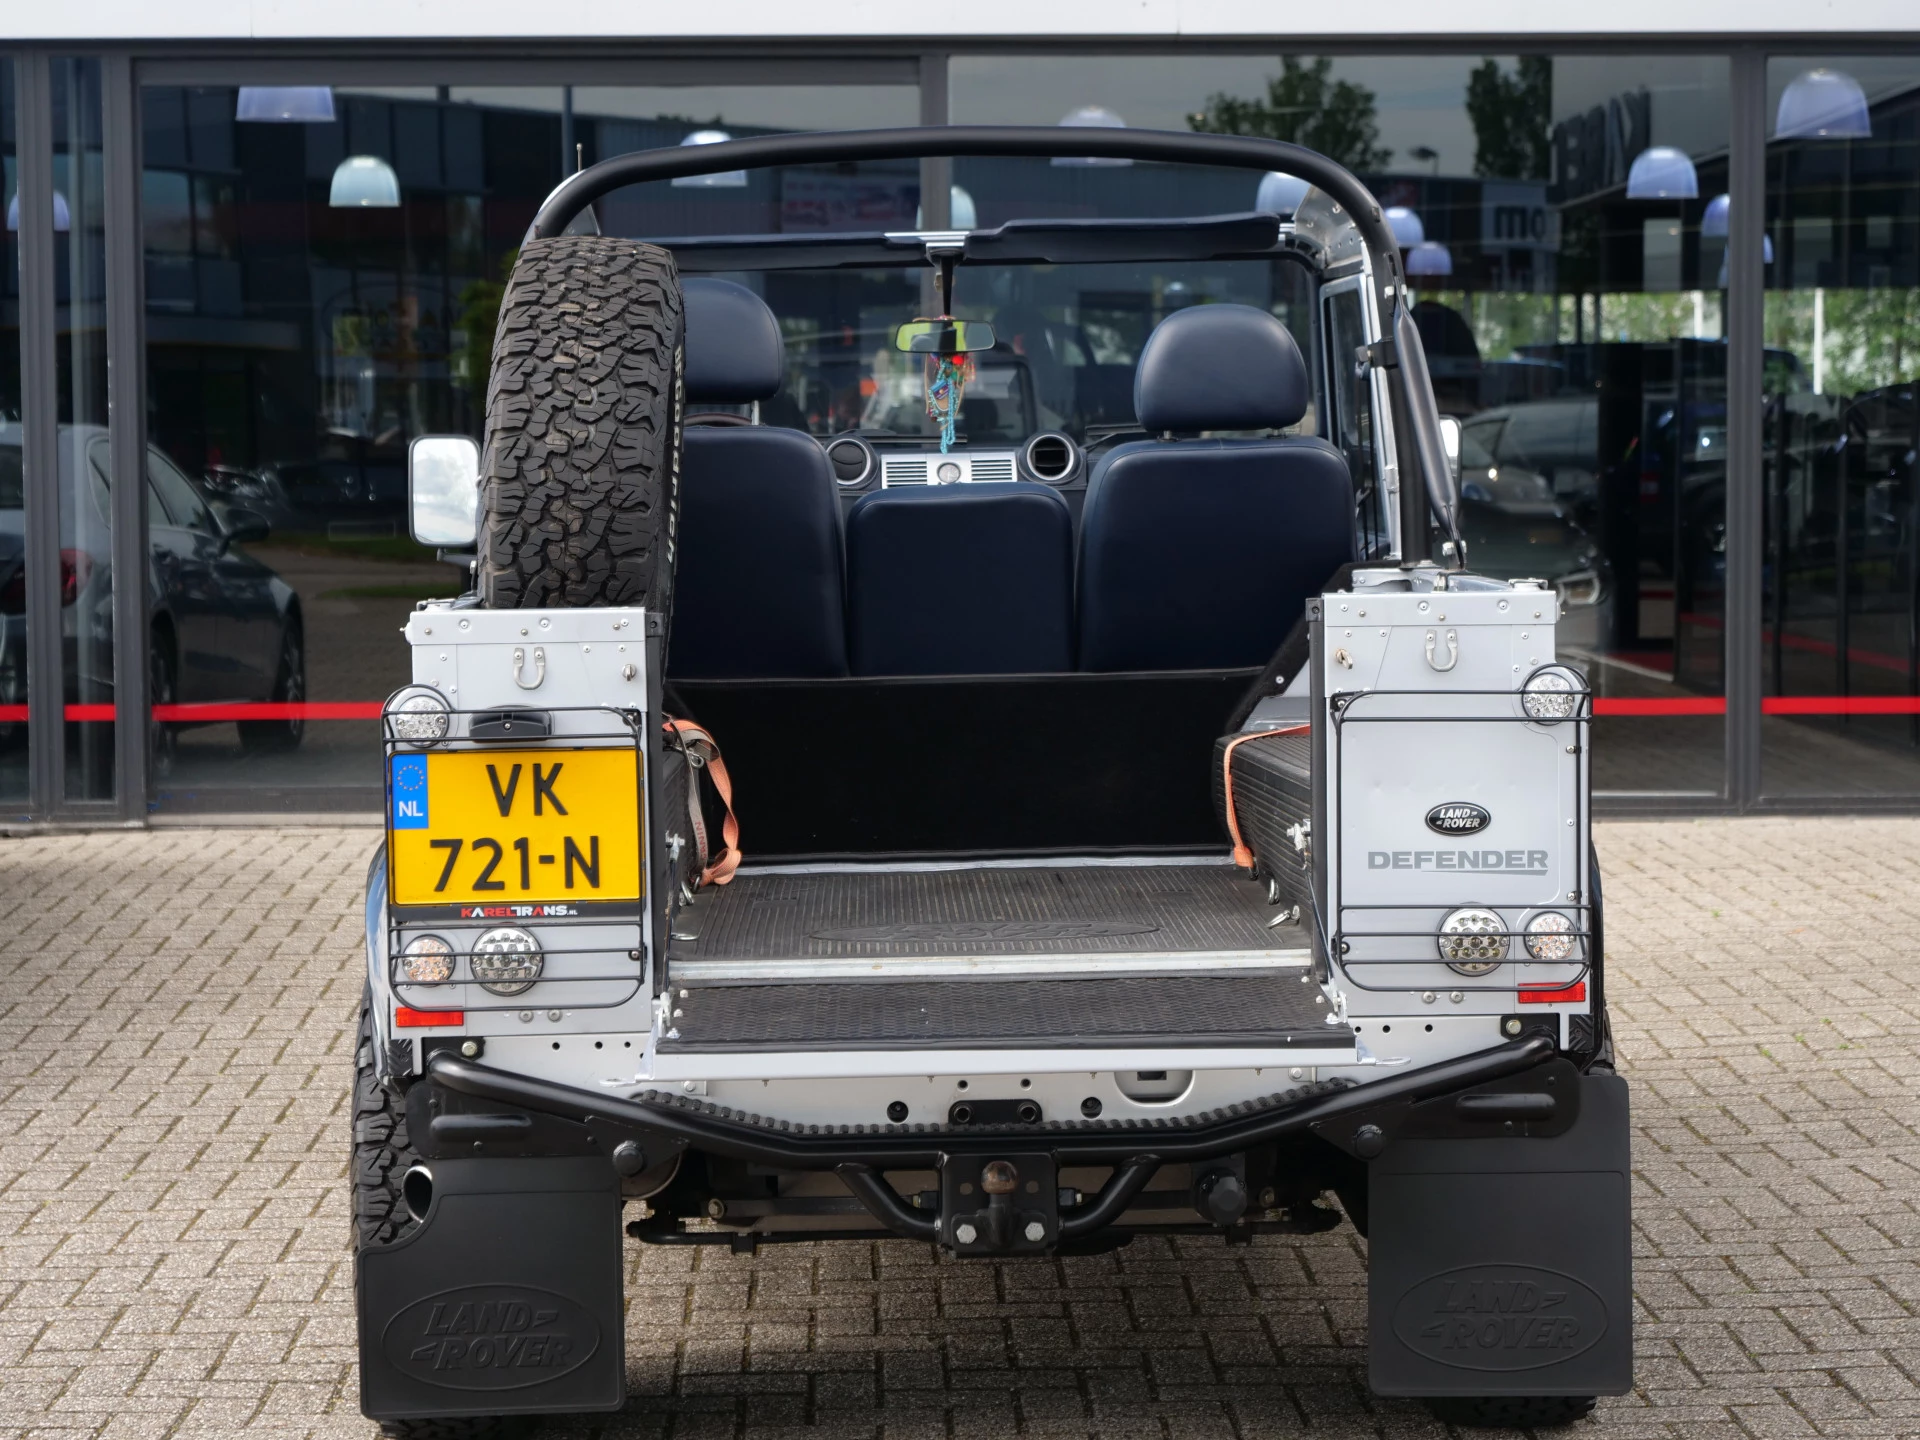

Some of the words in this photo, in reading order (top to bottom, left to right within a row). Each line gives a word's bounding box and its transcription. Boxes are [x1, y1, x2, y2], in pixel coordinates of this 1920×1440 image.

[668, 344, 682, 564] BFGoodrich
[485, 763, 568, 817] VK
[398, 800, 424, 817] NL
[1439, 808, 1471, 818] LAND
[1442, 818, 1481, 828] ROVER
[429, 835, 600, 892] 721-N
[1368, 850, 1549, 871] DEFENDER
[1434, 1279, 1542, 1314] LAND
[424, 1300, 534, 1336] LAND
[1442, 1315, 1581, 1350] ROVER
[434, 1334, 573, 1371] ROVER
